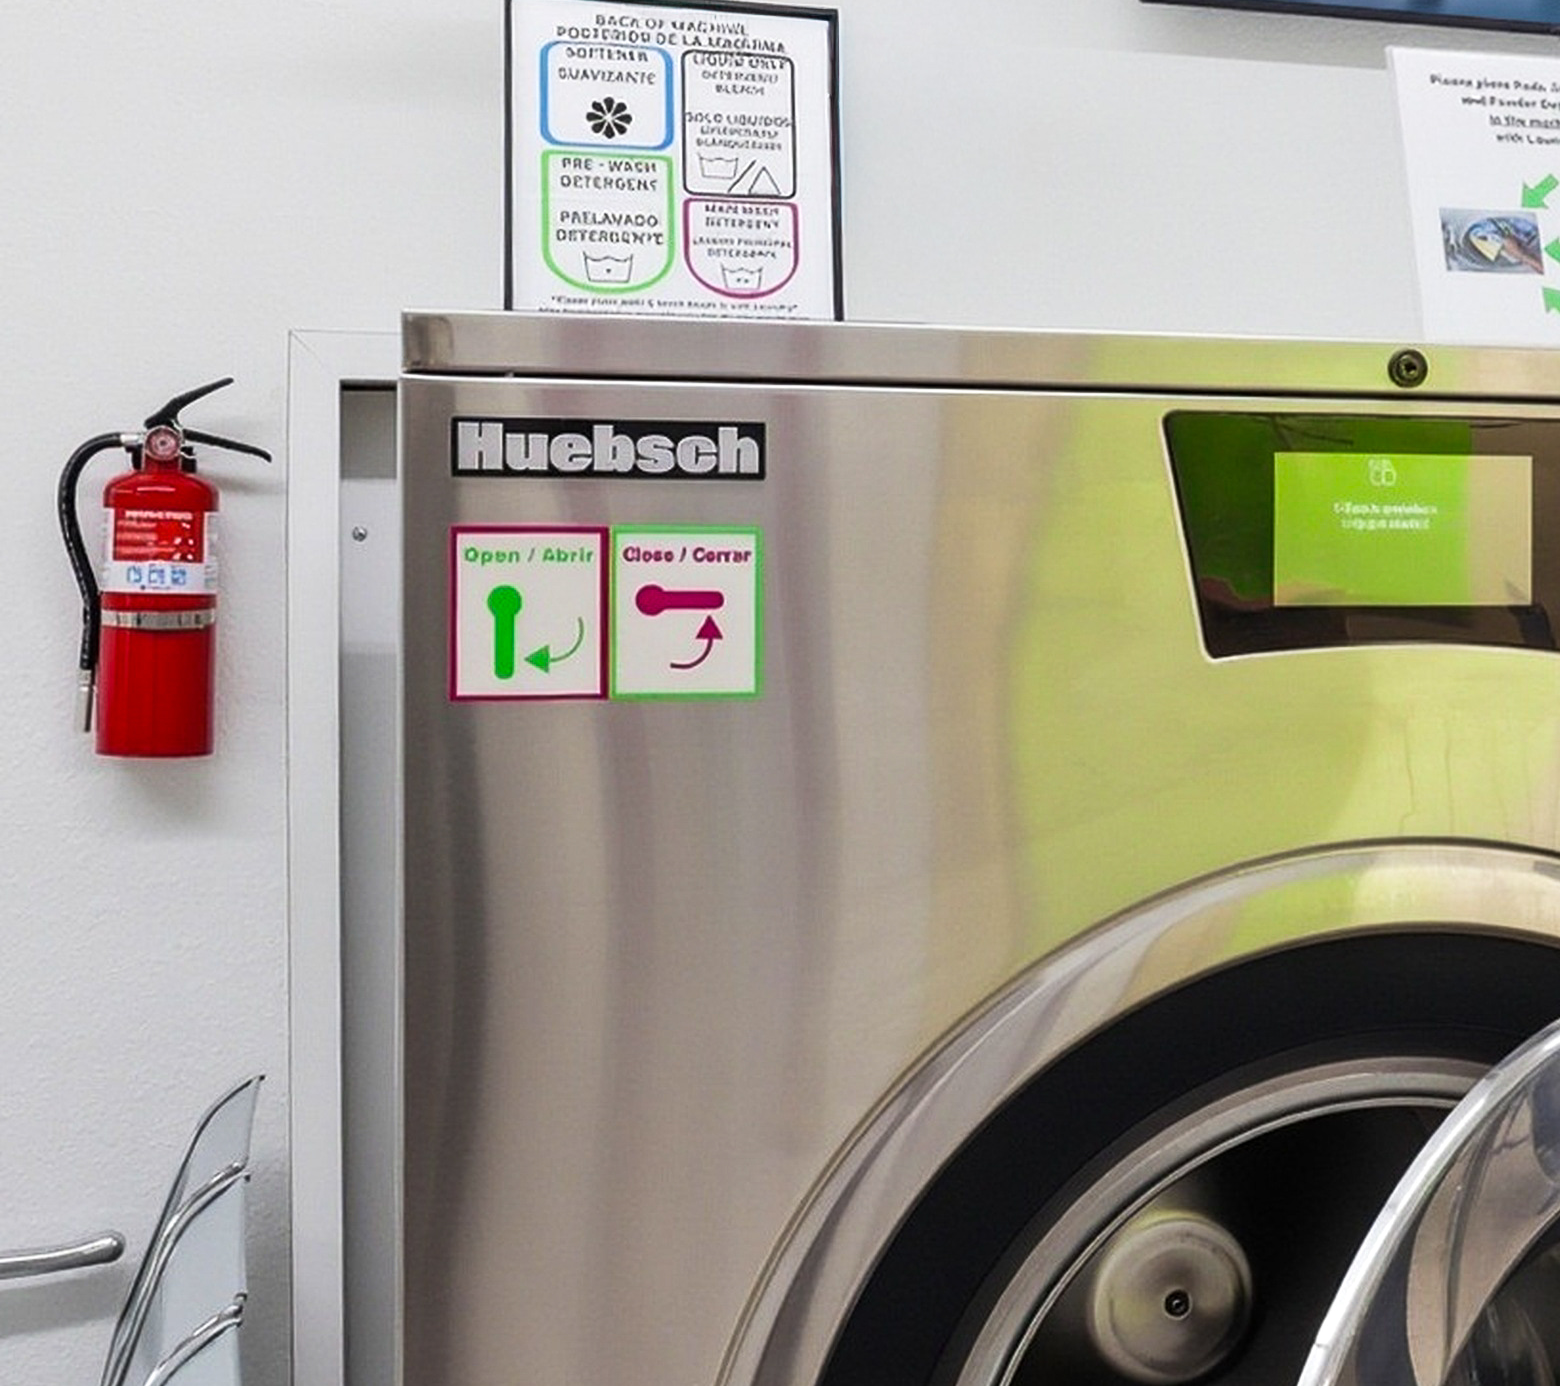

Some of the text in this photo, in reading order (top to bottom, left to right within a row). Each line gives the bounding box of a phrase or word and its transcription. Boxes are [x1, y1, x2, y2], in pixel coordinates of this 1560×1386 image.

[458, 422, 759, 474] Huebsch
[463, 547, 520, 566] Open
[542, 546, 595, 564] Abrir
[622, 546, 675, 564] Close
[692, 546, 753, 564] Cerrar
